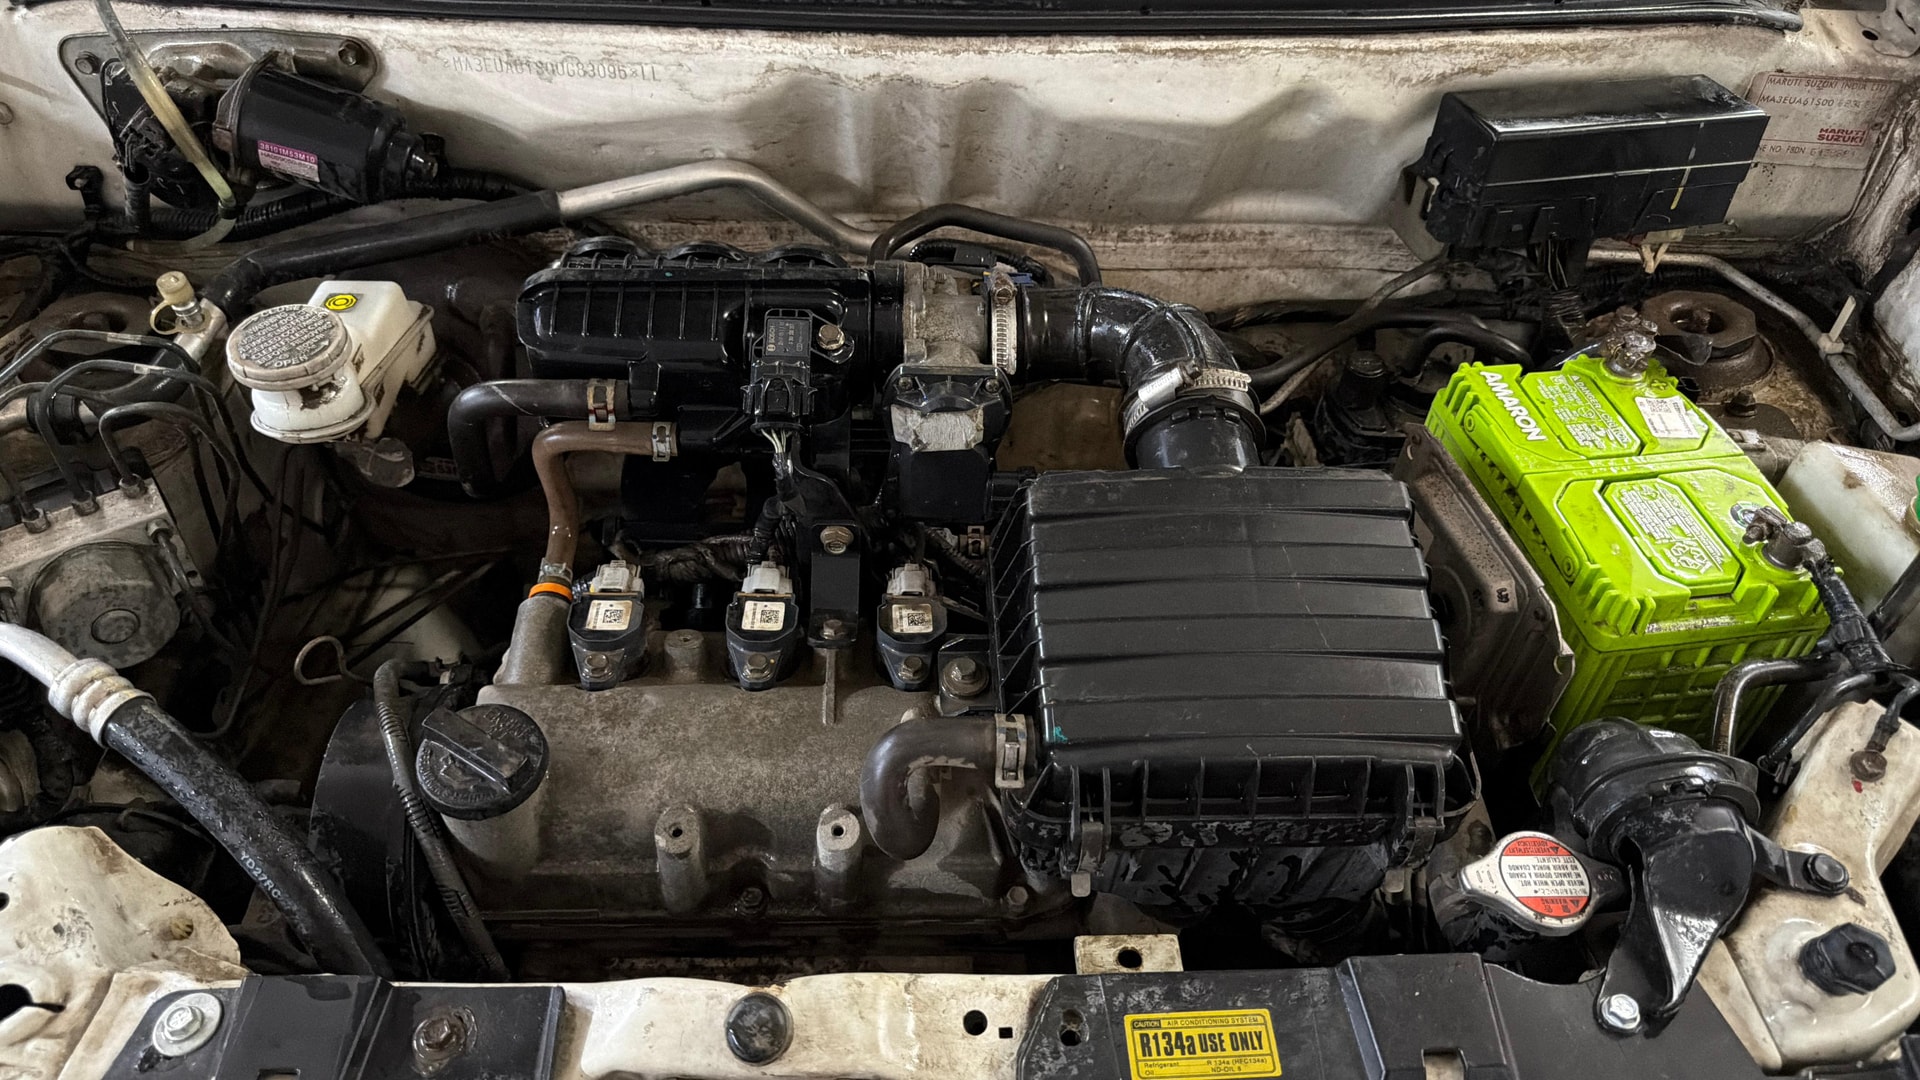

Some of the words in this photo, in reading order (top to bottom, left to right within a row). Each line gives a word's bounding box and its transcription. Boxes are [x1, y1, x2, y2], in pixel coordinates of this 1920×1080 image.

[1768, 78, 1800, 87] MARUTI
[1805, 80, 1838, 89] SUZUKI
[1841, 82, 1866, 90] INDIA
[1819, 128, 1866, 136] MARUTI
[1817, 134, 1864, 143] SUZUKI
[274, 354, 309, 368] OPEN
[1480, 371, 1548, 441] AMARON
[1133, 1020, 1160, 1028] CAUTION
[1179, 1018, 1230, 1026] CONDITIONING
[1231, 1016, 1259, 1024] SYSTEM
[1139, 1031, 1197, 1057] R134a
[1198, 1032, 1227, 1053] USE
[1230, 1031, 1264, 1052] ONLY
[1144, 1061, 1180, 1069] Refrigerant
